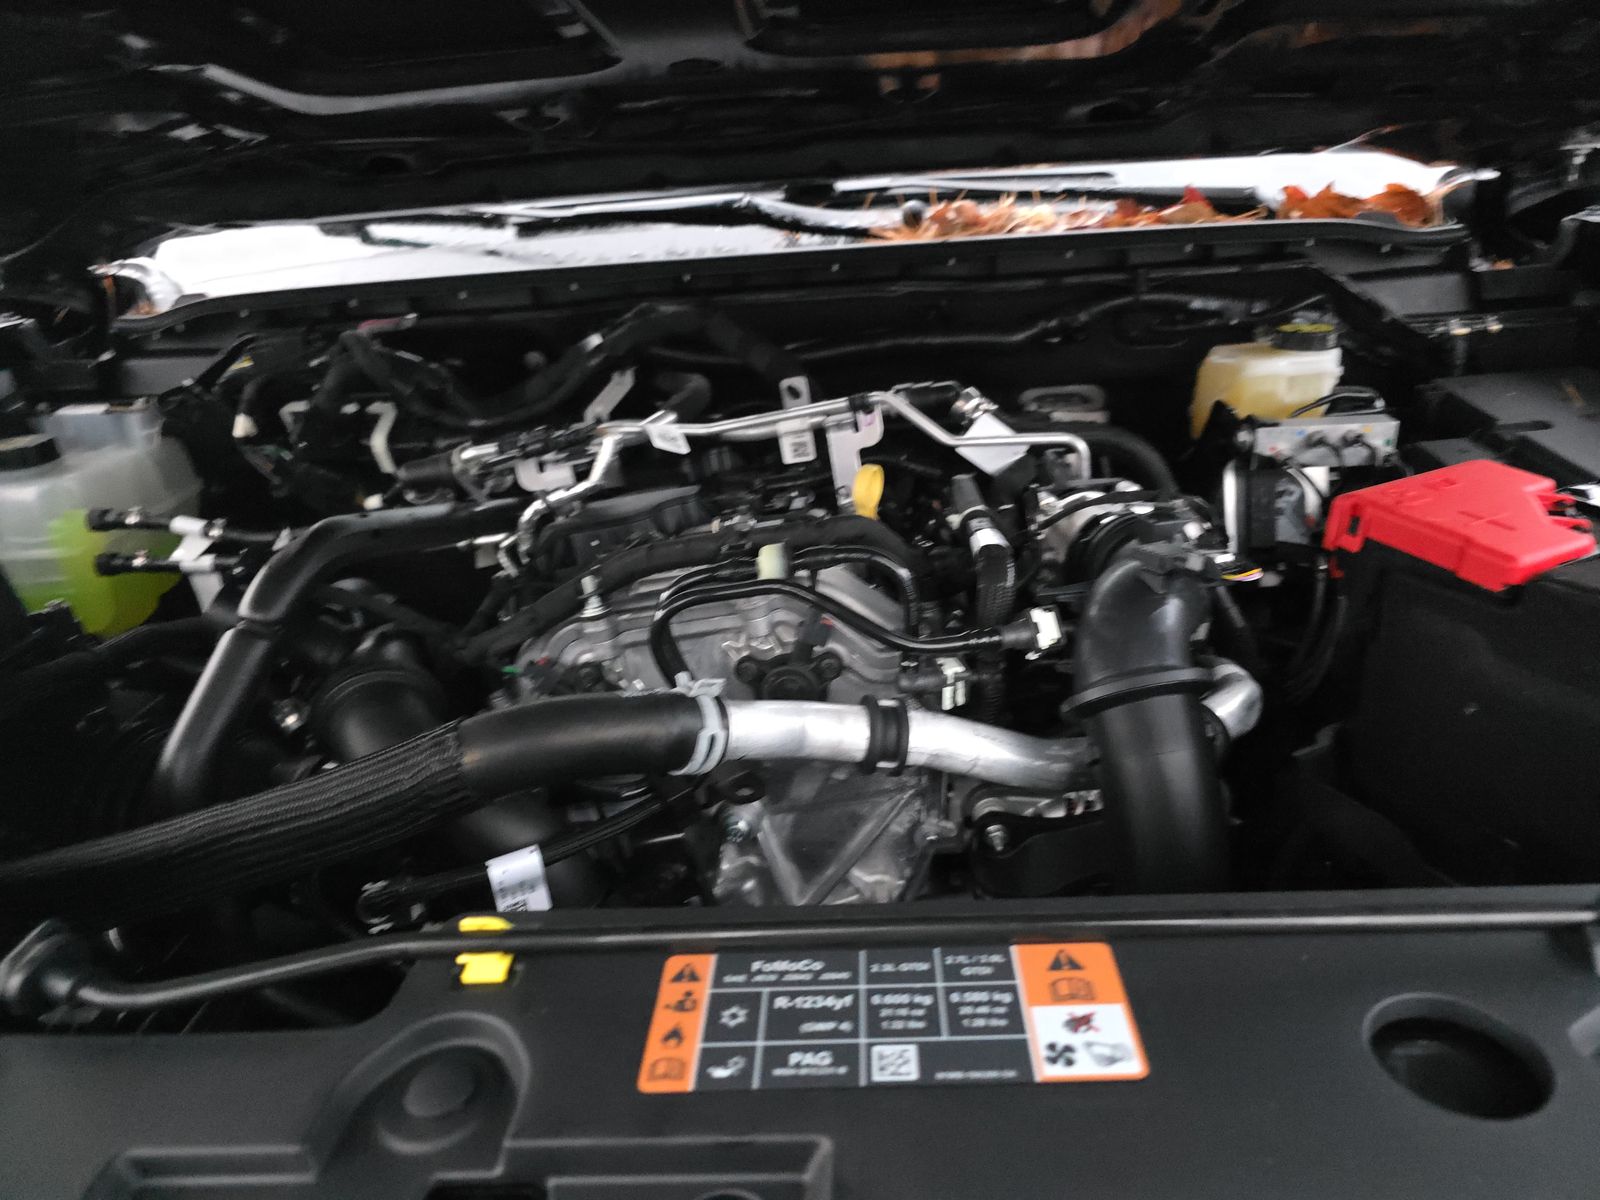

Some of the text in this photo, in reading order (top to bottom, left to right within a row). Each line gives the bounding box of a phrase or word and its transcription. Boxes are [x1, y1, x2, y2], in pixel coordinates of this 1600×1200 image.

[751, 959, 825, 972] FoMoCo
[774, 994, 854, 1010] R-1234yf
[788, 1051, 832, 1066] PAG
